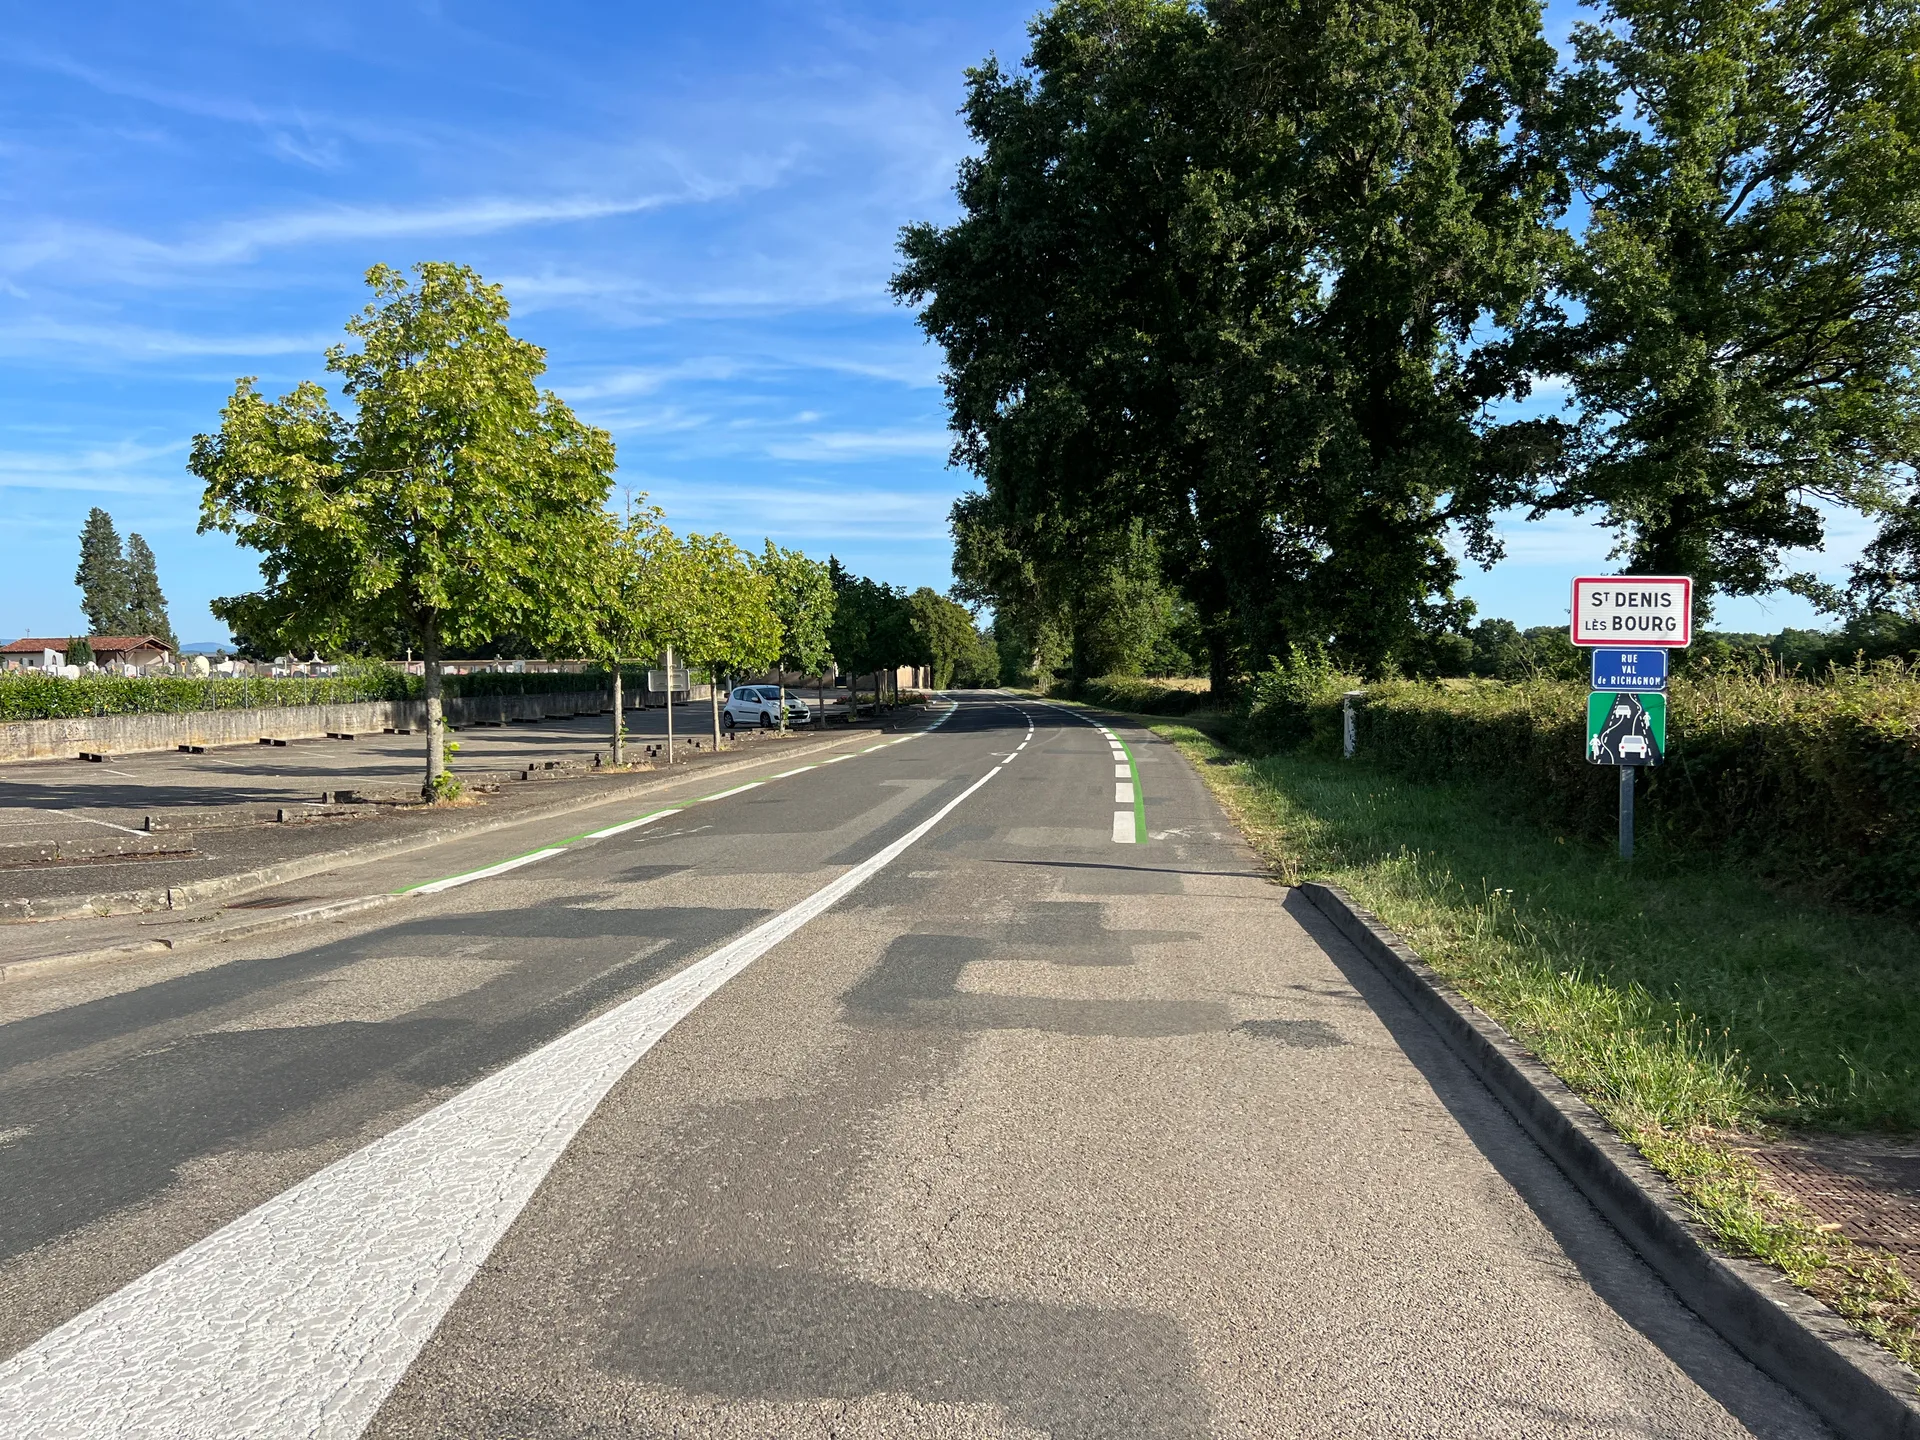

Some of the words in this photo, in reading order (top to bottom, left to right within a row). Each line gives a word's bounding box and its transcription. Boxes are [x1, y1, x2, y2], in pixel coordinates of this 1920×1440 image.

[1615, 592, 1672, 608] DENIS
[1585, 619, 1607, 631] LÈS
[1612, 616, 1676, 632] BOURG
[1621, 654, 1638, 663] RUE
[1621, 665, 1637, 674] VAL
[1597, 676, 1606, 685] de
[1610, 676, 1661, 686] RICHAGNON
